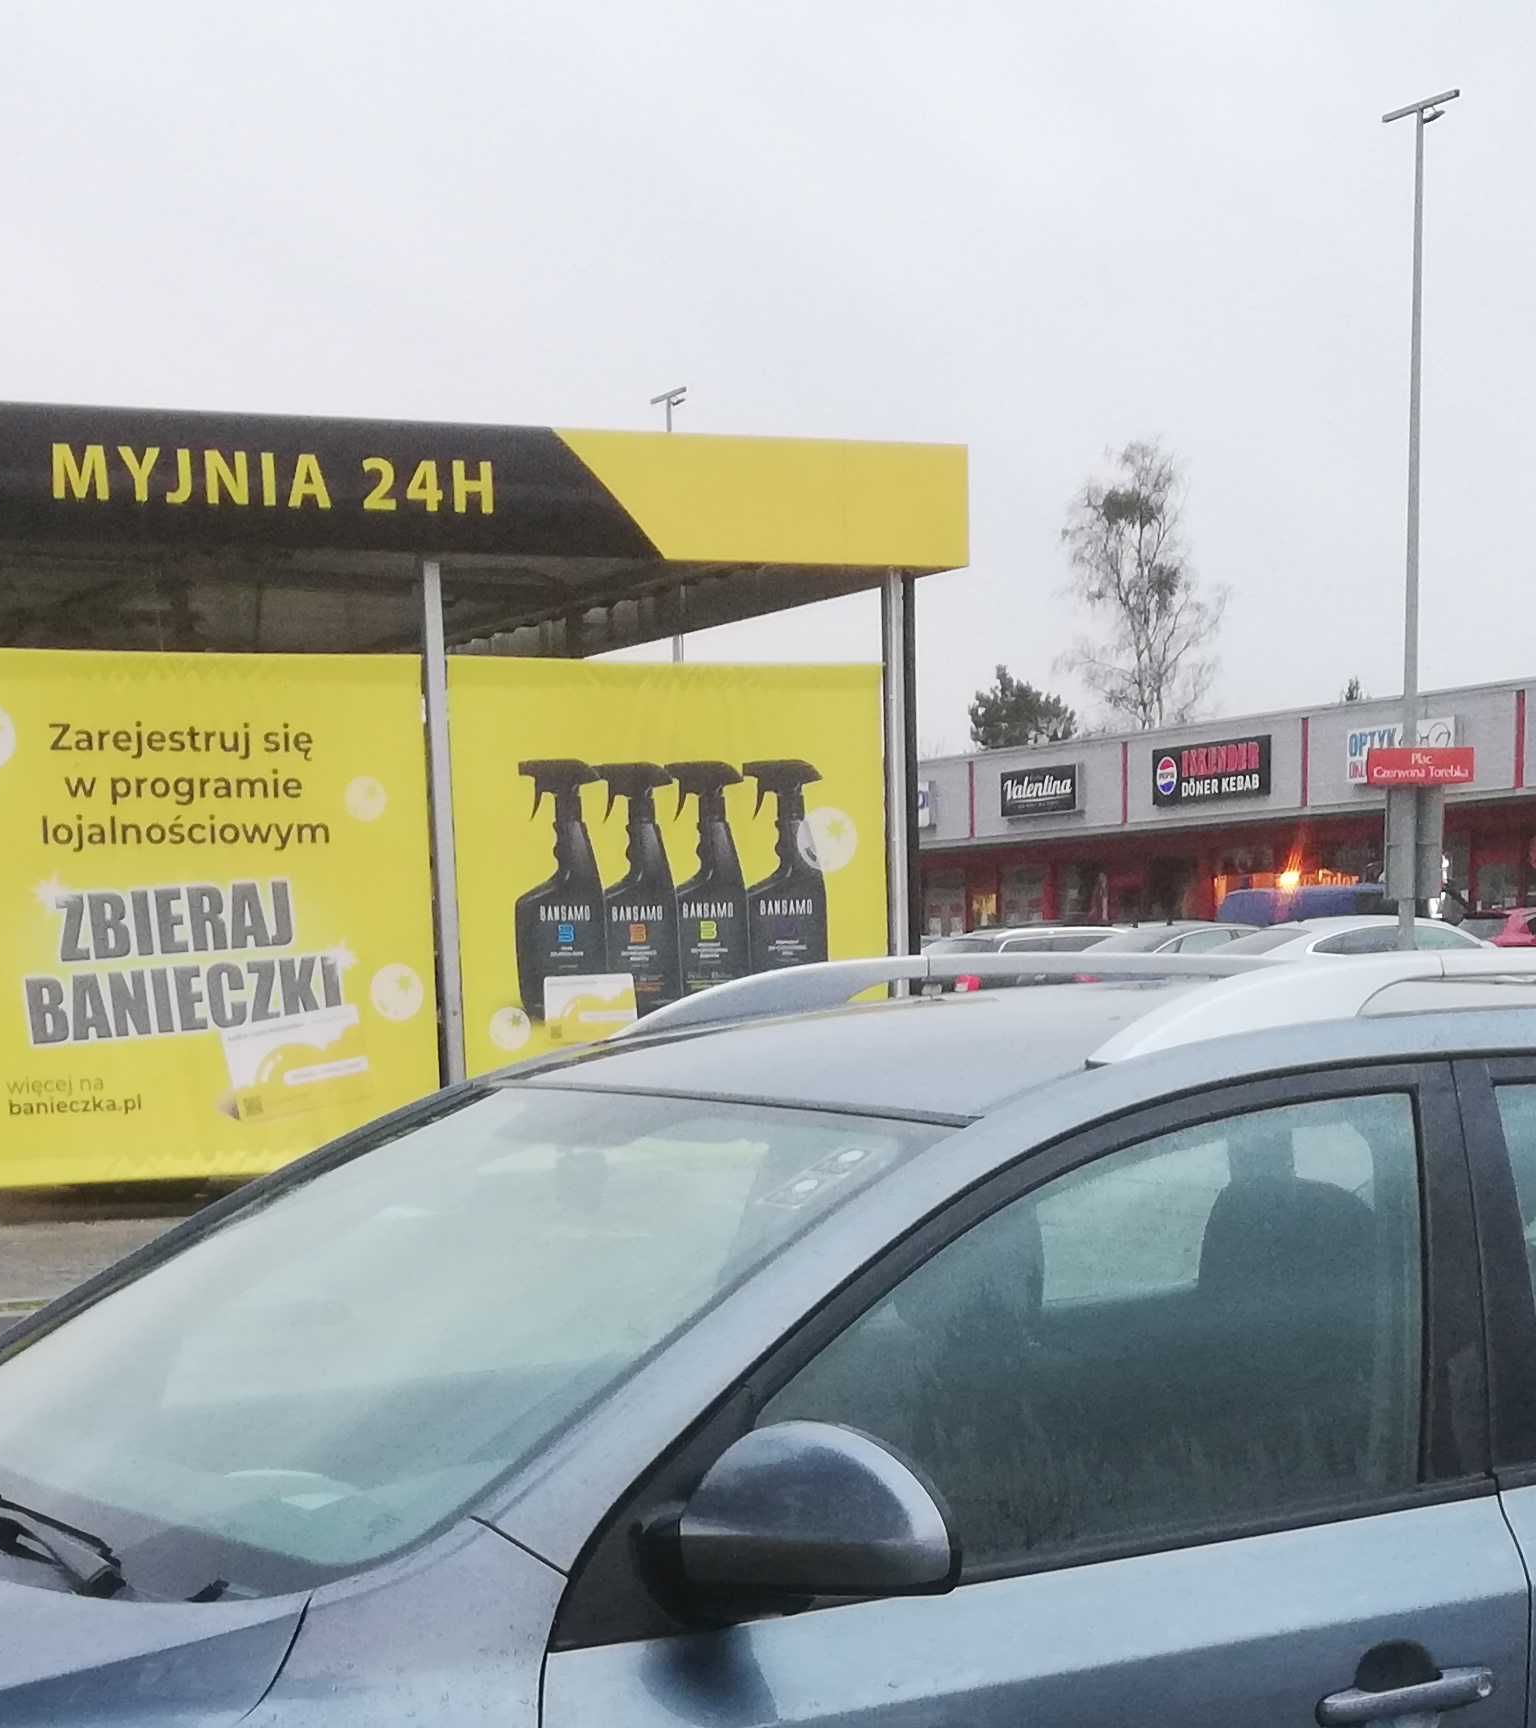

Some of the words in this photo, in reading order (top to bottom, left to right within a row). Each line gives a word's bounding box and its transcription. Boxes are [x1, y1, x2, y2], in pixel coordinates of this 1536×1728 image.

[51, 443, 332, 510] MYJNIA
[363, 456, 495, 514] 24H
[49, 721, 251, 760] Zarejestruj
[263, 722, 314, 762] się
[1181, 741, 1260, 778] ISKENDER
[1411, 752, 1433, 765] Plac
[1373, 766, 1425, 778] Czerwona
[1429, 765, 1469, 778] Torebka
[64, 776, 96, 799] w
[110, 768, 303, 806] programie
[1002, 773, 1073, 802] Valentina
[1181, 778, 1219, 798] DÖNER
[1221, 773, 1260, 793] KEBAB
[41, 813, 331, 853] lojalnościowym
[539, 904, 591, 921] BANSAMO
[611, 904, 663, 922] BANSAMO
[682, 901, 734, 919] BANSAMO
[759, 898, 813, 916] BANSAMO
[55, 879, 294, 963] ZBIERAJ
[24, 954, 343, 1045] BANIECZKI
[6, 1074, 74, 1097] więcej
[79, 1076, 105, 1092] na
[8, 1095, 143, 1117] banieczka.pl
